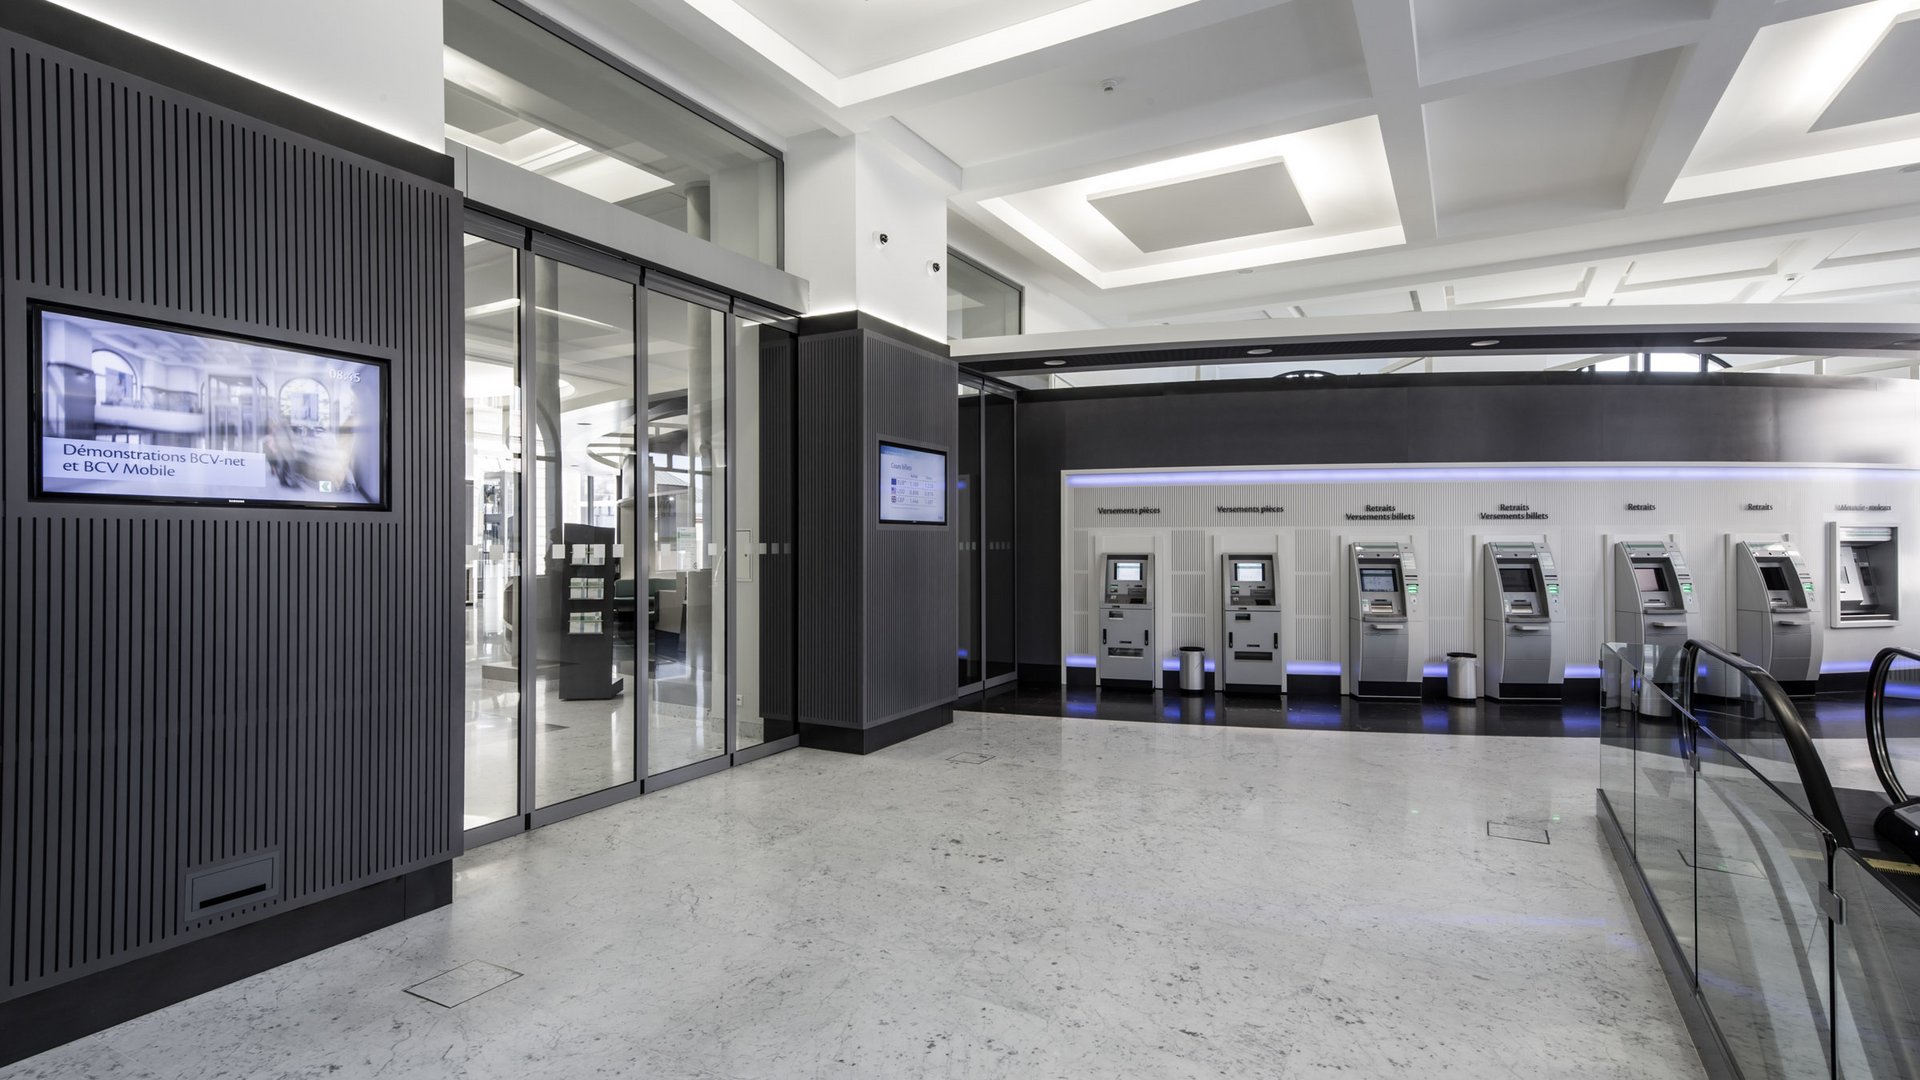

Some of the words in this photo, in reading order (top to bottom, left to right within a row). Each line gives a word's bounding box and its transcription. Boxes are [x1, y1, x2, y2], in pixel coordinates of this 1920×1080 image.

[63, 443, 186, 464] Démonstrations
[190, 452, 246, 467] BCV-net
[62, 462, 79, 472] et
[84, 460, 119, 474] BCV
[123, 463, 176, 477] Mobile
[1217, 505, 1260, 513] Versements
[1260, 505, 1284, 514] pièces
[1365, 504, 1396, 512] Retraits
[1499, 503, 1530, 511] Retraits
[1627, 503, 1656, 511] Retraits
[1747, 503, 1773, 511] Retraits
[1098, 507, 1138, 515] Versements
[1138, 507, 1161, 516] pièces
[1346, 513, 1391, 521] Versements
[1391, 512, 1415, 521] billets
[1480, 512, 1525, 520] Versements
[1525, 512, 1549, 520] billets
